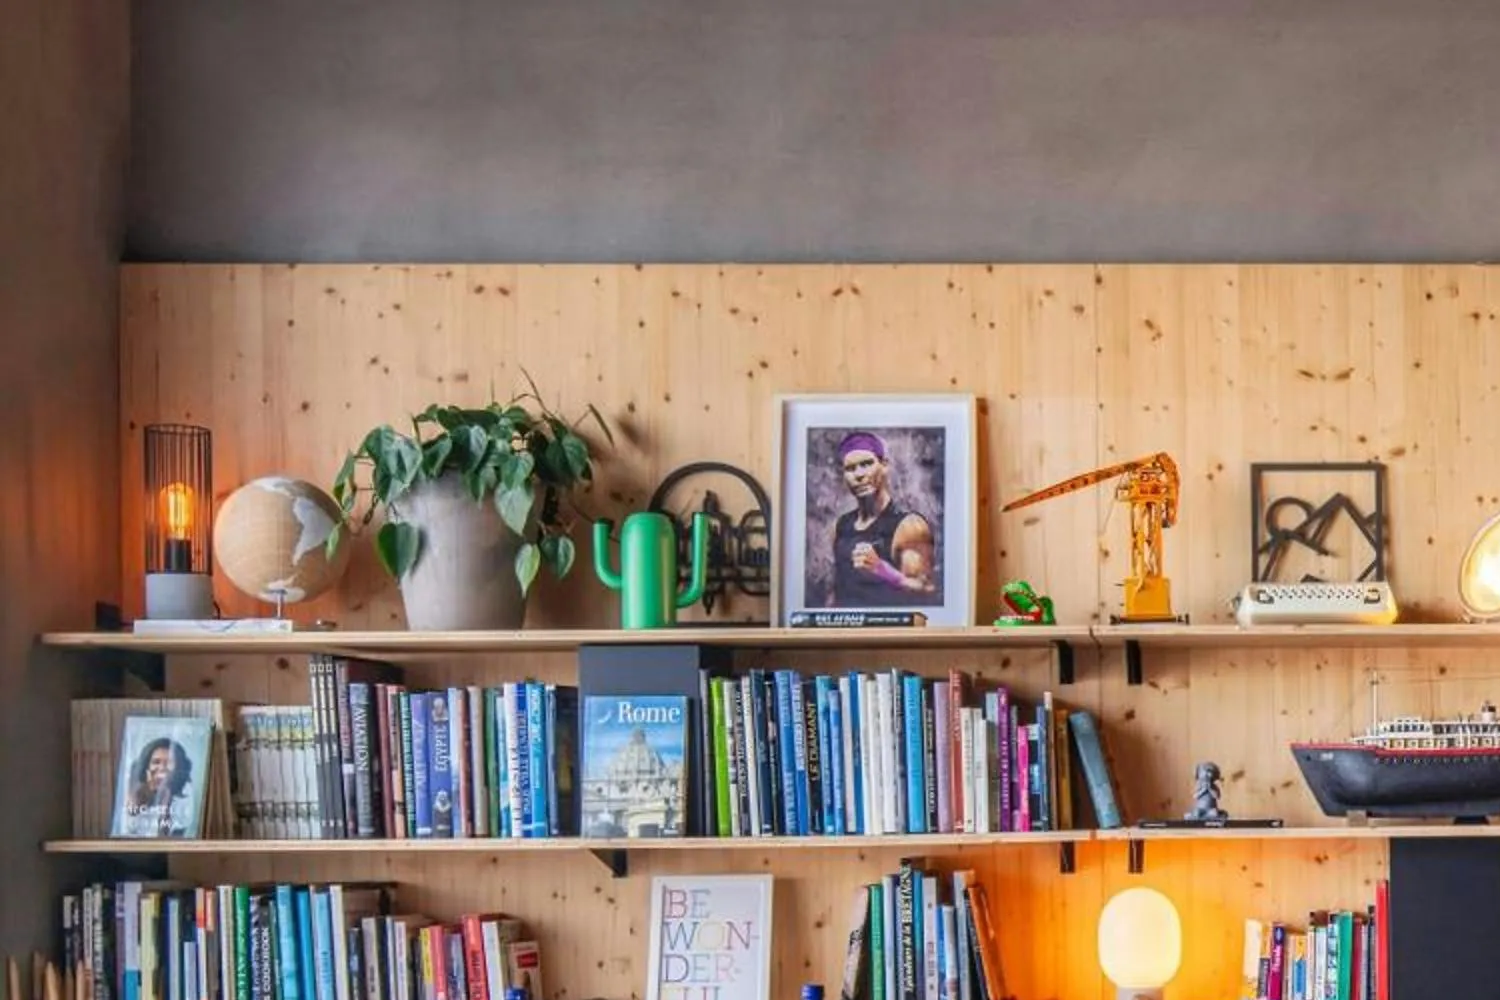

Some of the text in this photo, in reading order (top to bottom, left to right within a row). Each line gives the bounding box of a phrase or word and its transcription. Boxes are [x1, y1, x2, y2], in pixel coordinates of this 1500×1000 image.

[617, 701, 681, 723] Rome
[352, 707, 368, 772] AVIATION
[664, 889, 711, 919] BE
